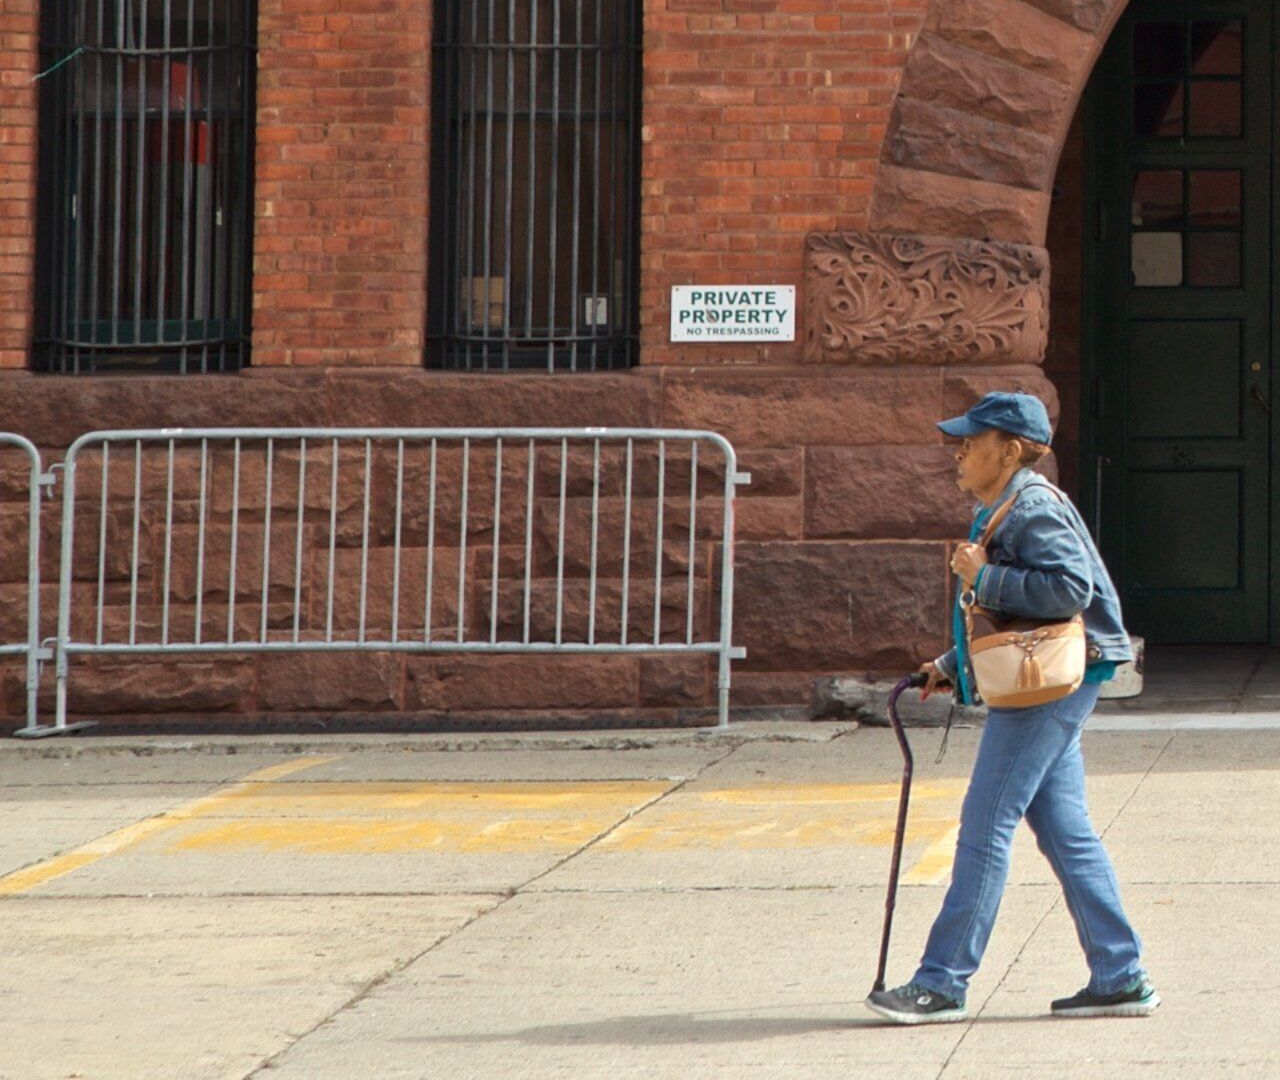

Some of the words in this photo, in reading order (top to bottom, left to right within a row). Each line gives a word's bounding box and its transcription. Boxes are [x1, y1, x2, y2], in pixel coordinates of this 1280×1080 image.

[690, 291, 777, 305] PRIVATE
[679, 309, 788, 324] PROPERTY
[686, 327, 702, 336] NO
[706, 327, 780, 336] TRESPASSING
